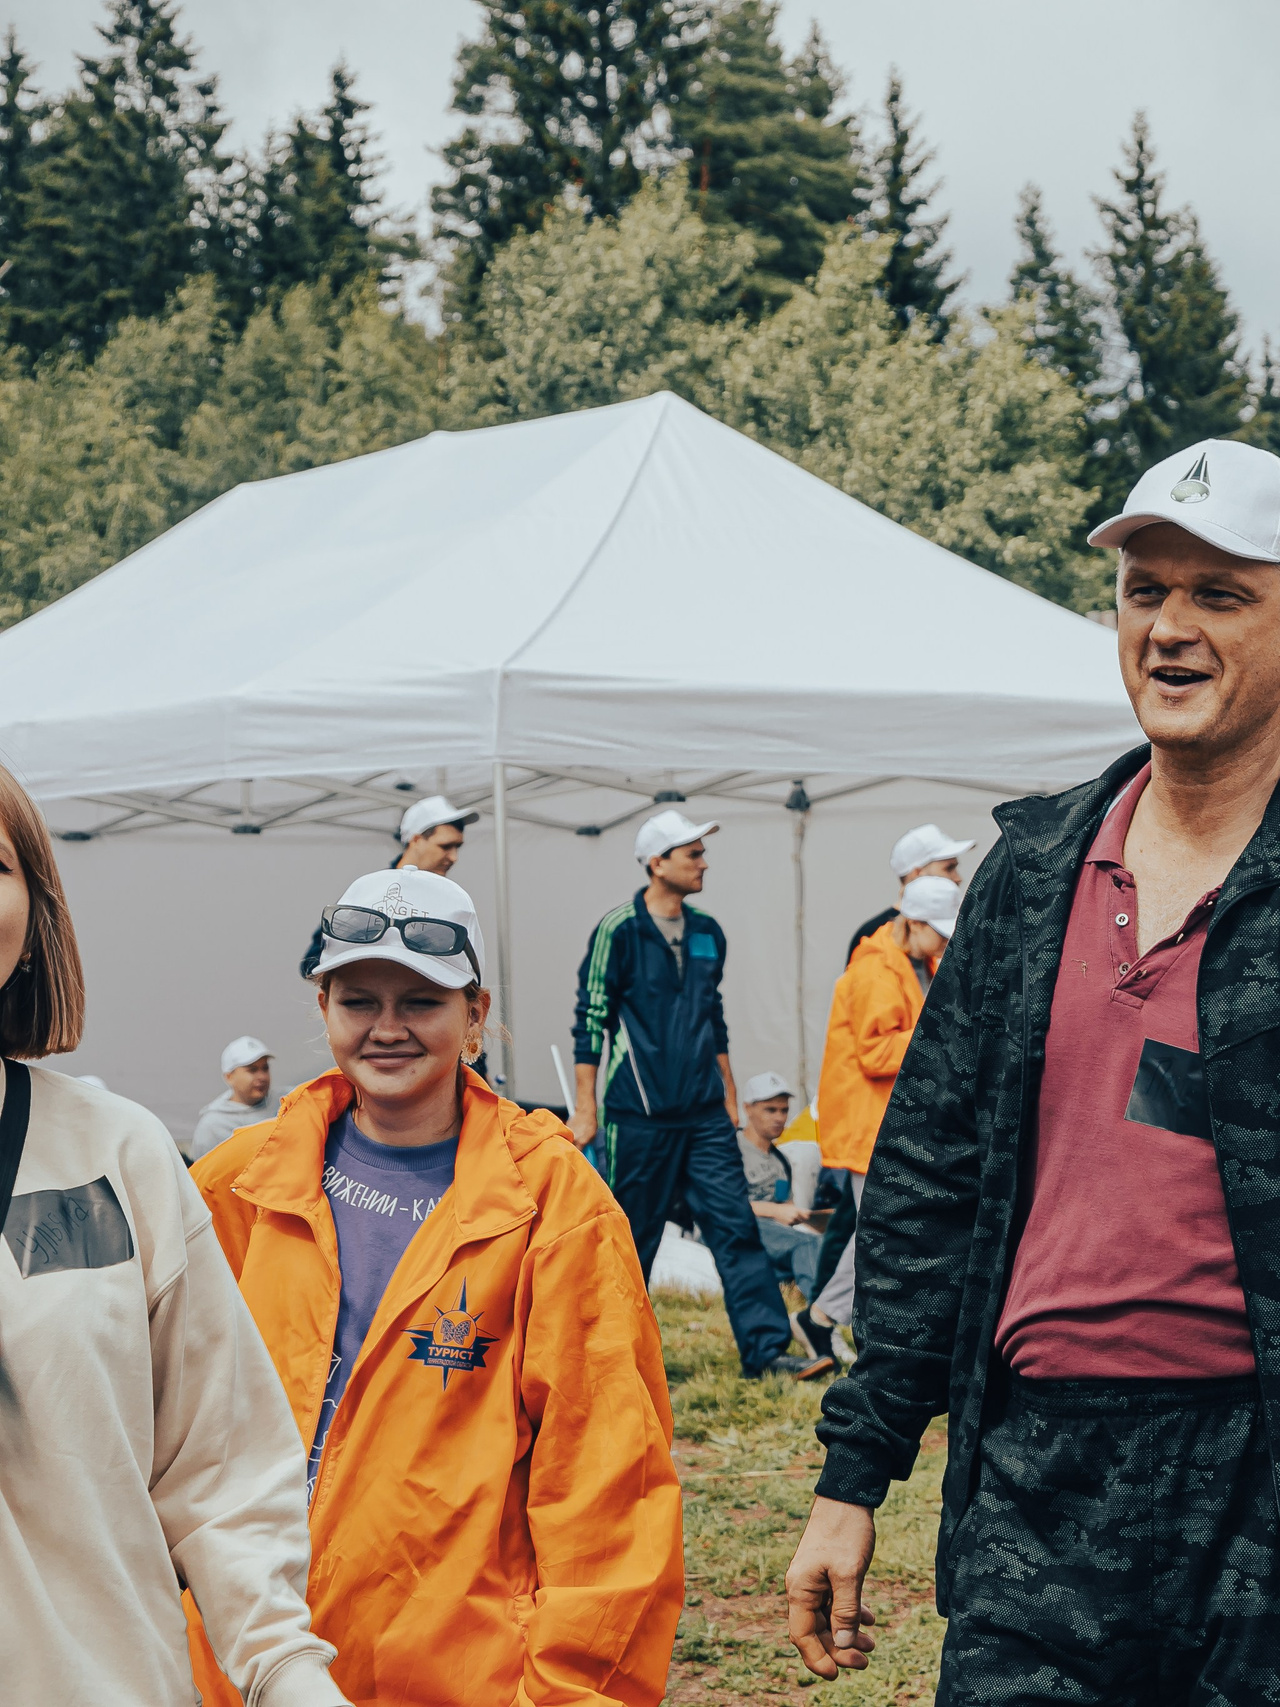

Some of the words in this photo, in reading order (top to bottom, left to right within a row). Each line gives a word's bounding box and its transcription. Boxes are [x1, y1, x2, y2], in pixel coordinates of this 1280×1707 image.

[321, 1161, 398, 1218] ВИЖЕНИИ
[412, 1197, 442, 1222] КА
[428, 1346, 474, 1361] ТУРИСТ
